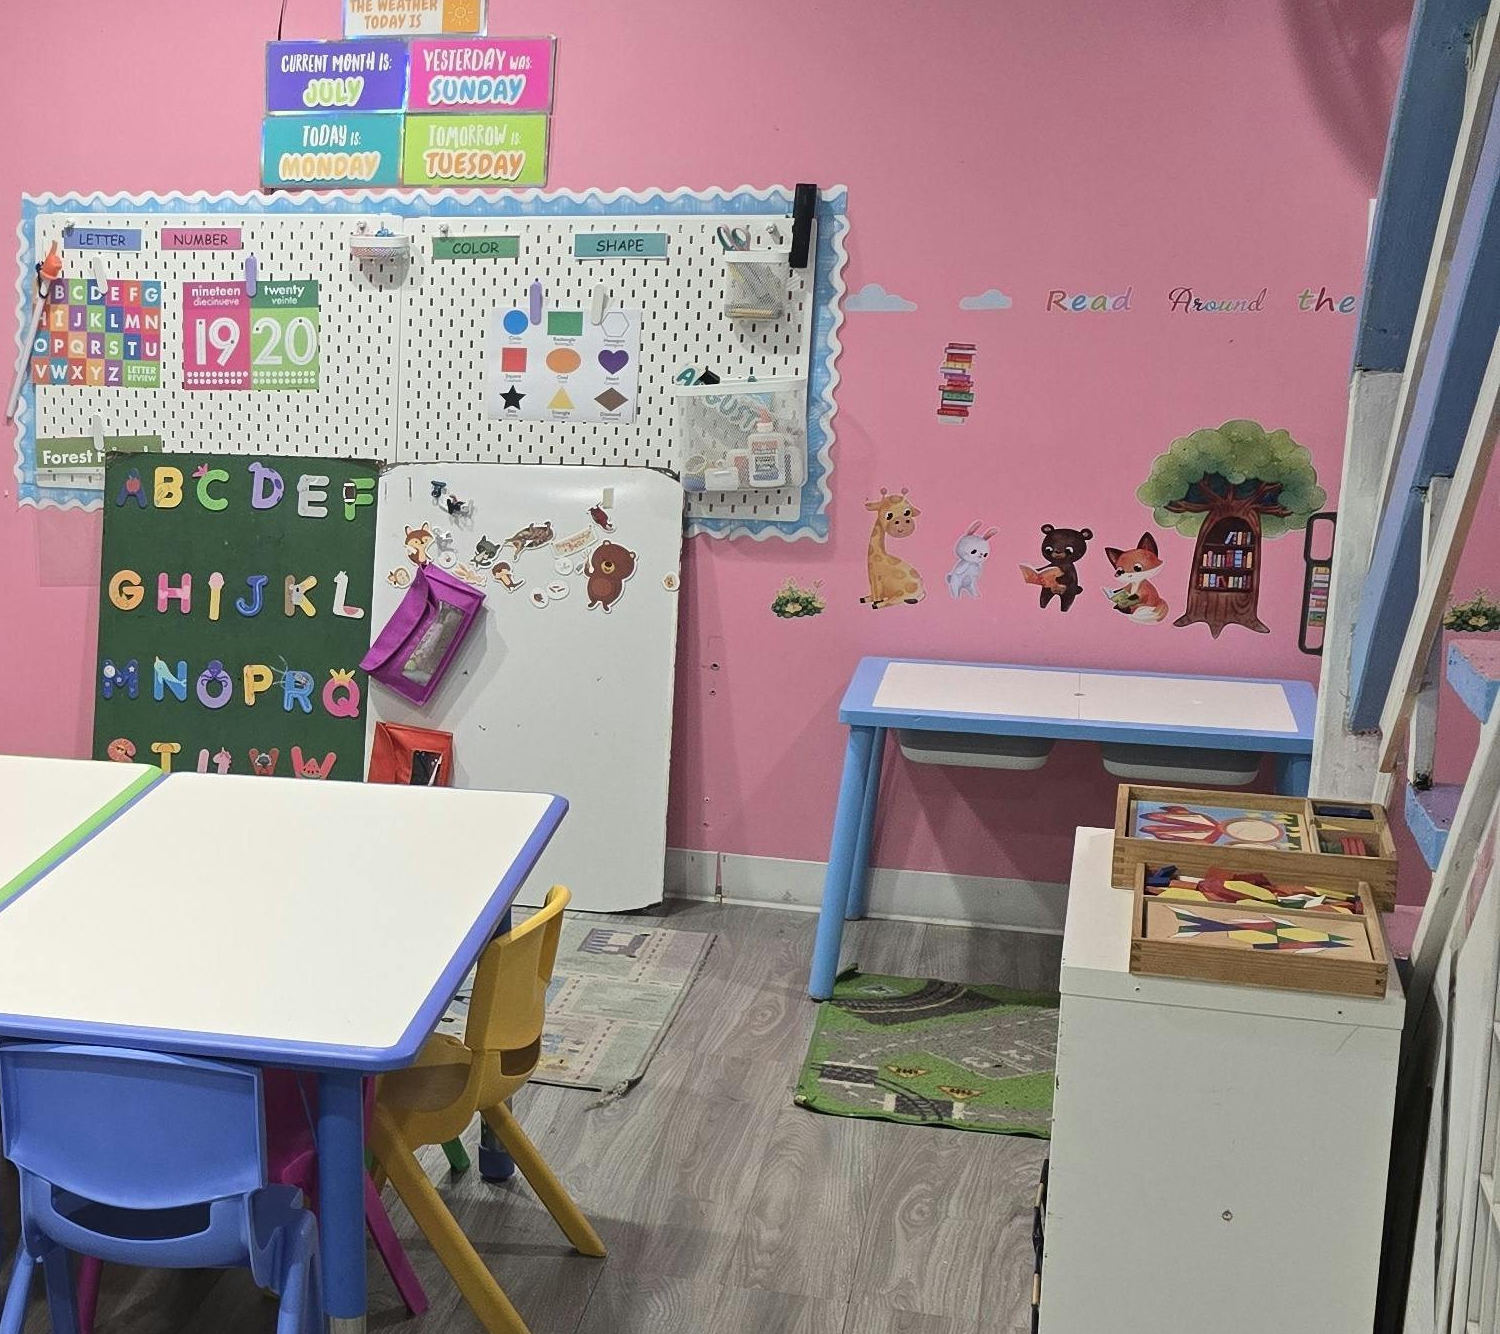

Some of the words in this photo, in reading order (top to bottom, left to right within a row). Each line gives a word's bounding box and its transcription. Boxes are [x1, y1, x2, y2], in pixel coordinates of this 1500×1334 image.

[364, 14, 406, 30] TODAY
[409, 14, 422, 29] IS
[281, 54, 328, 73] CURRENT
[332, 51, 375, 73] MONTH
[379, 51, 392, 70] IS:
[423, 47, 506, 73] YESTERDAY
[509, 55, 533, 70] WAS:
[303, 76, 363, 105] JULY
[429, 76, 524, 103] SUNDAY
[303, 124, 347, 147] TODAY
[350, 130, 362, 145] IS:
[428, 124, 507, 147] TOMORROW
[280, 153, 379, 180] MONDAY
[426, 151, 523, 178] TUESDAY
[78, 233, 126, 246] LETTER
[173, 233, 229, 246] NUMBER
[595, 238, 645, 253] SHAPE
[451, 241, 500, 255] COLOR
[191, 285, 241, 297] nineteen
[264, 285, 305, 299] twenty
[193, 296, 240, 307] diecinueve
[271, 296, 298, 306] veinte
[1046, 287, 1132, 312] Read
[1168, 287, 1267, 314] Around
[1298, 287, 1357, 314] the
[194, 317, 241, 367] 19
[252, 317, 318, 366] 20
[127, 366, 156, 375] LETTER
[127, 374, 156, 383] REVIEW
[43, 449, 94, 465] Forest
